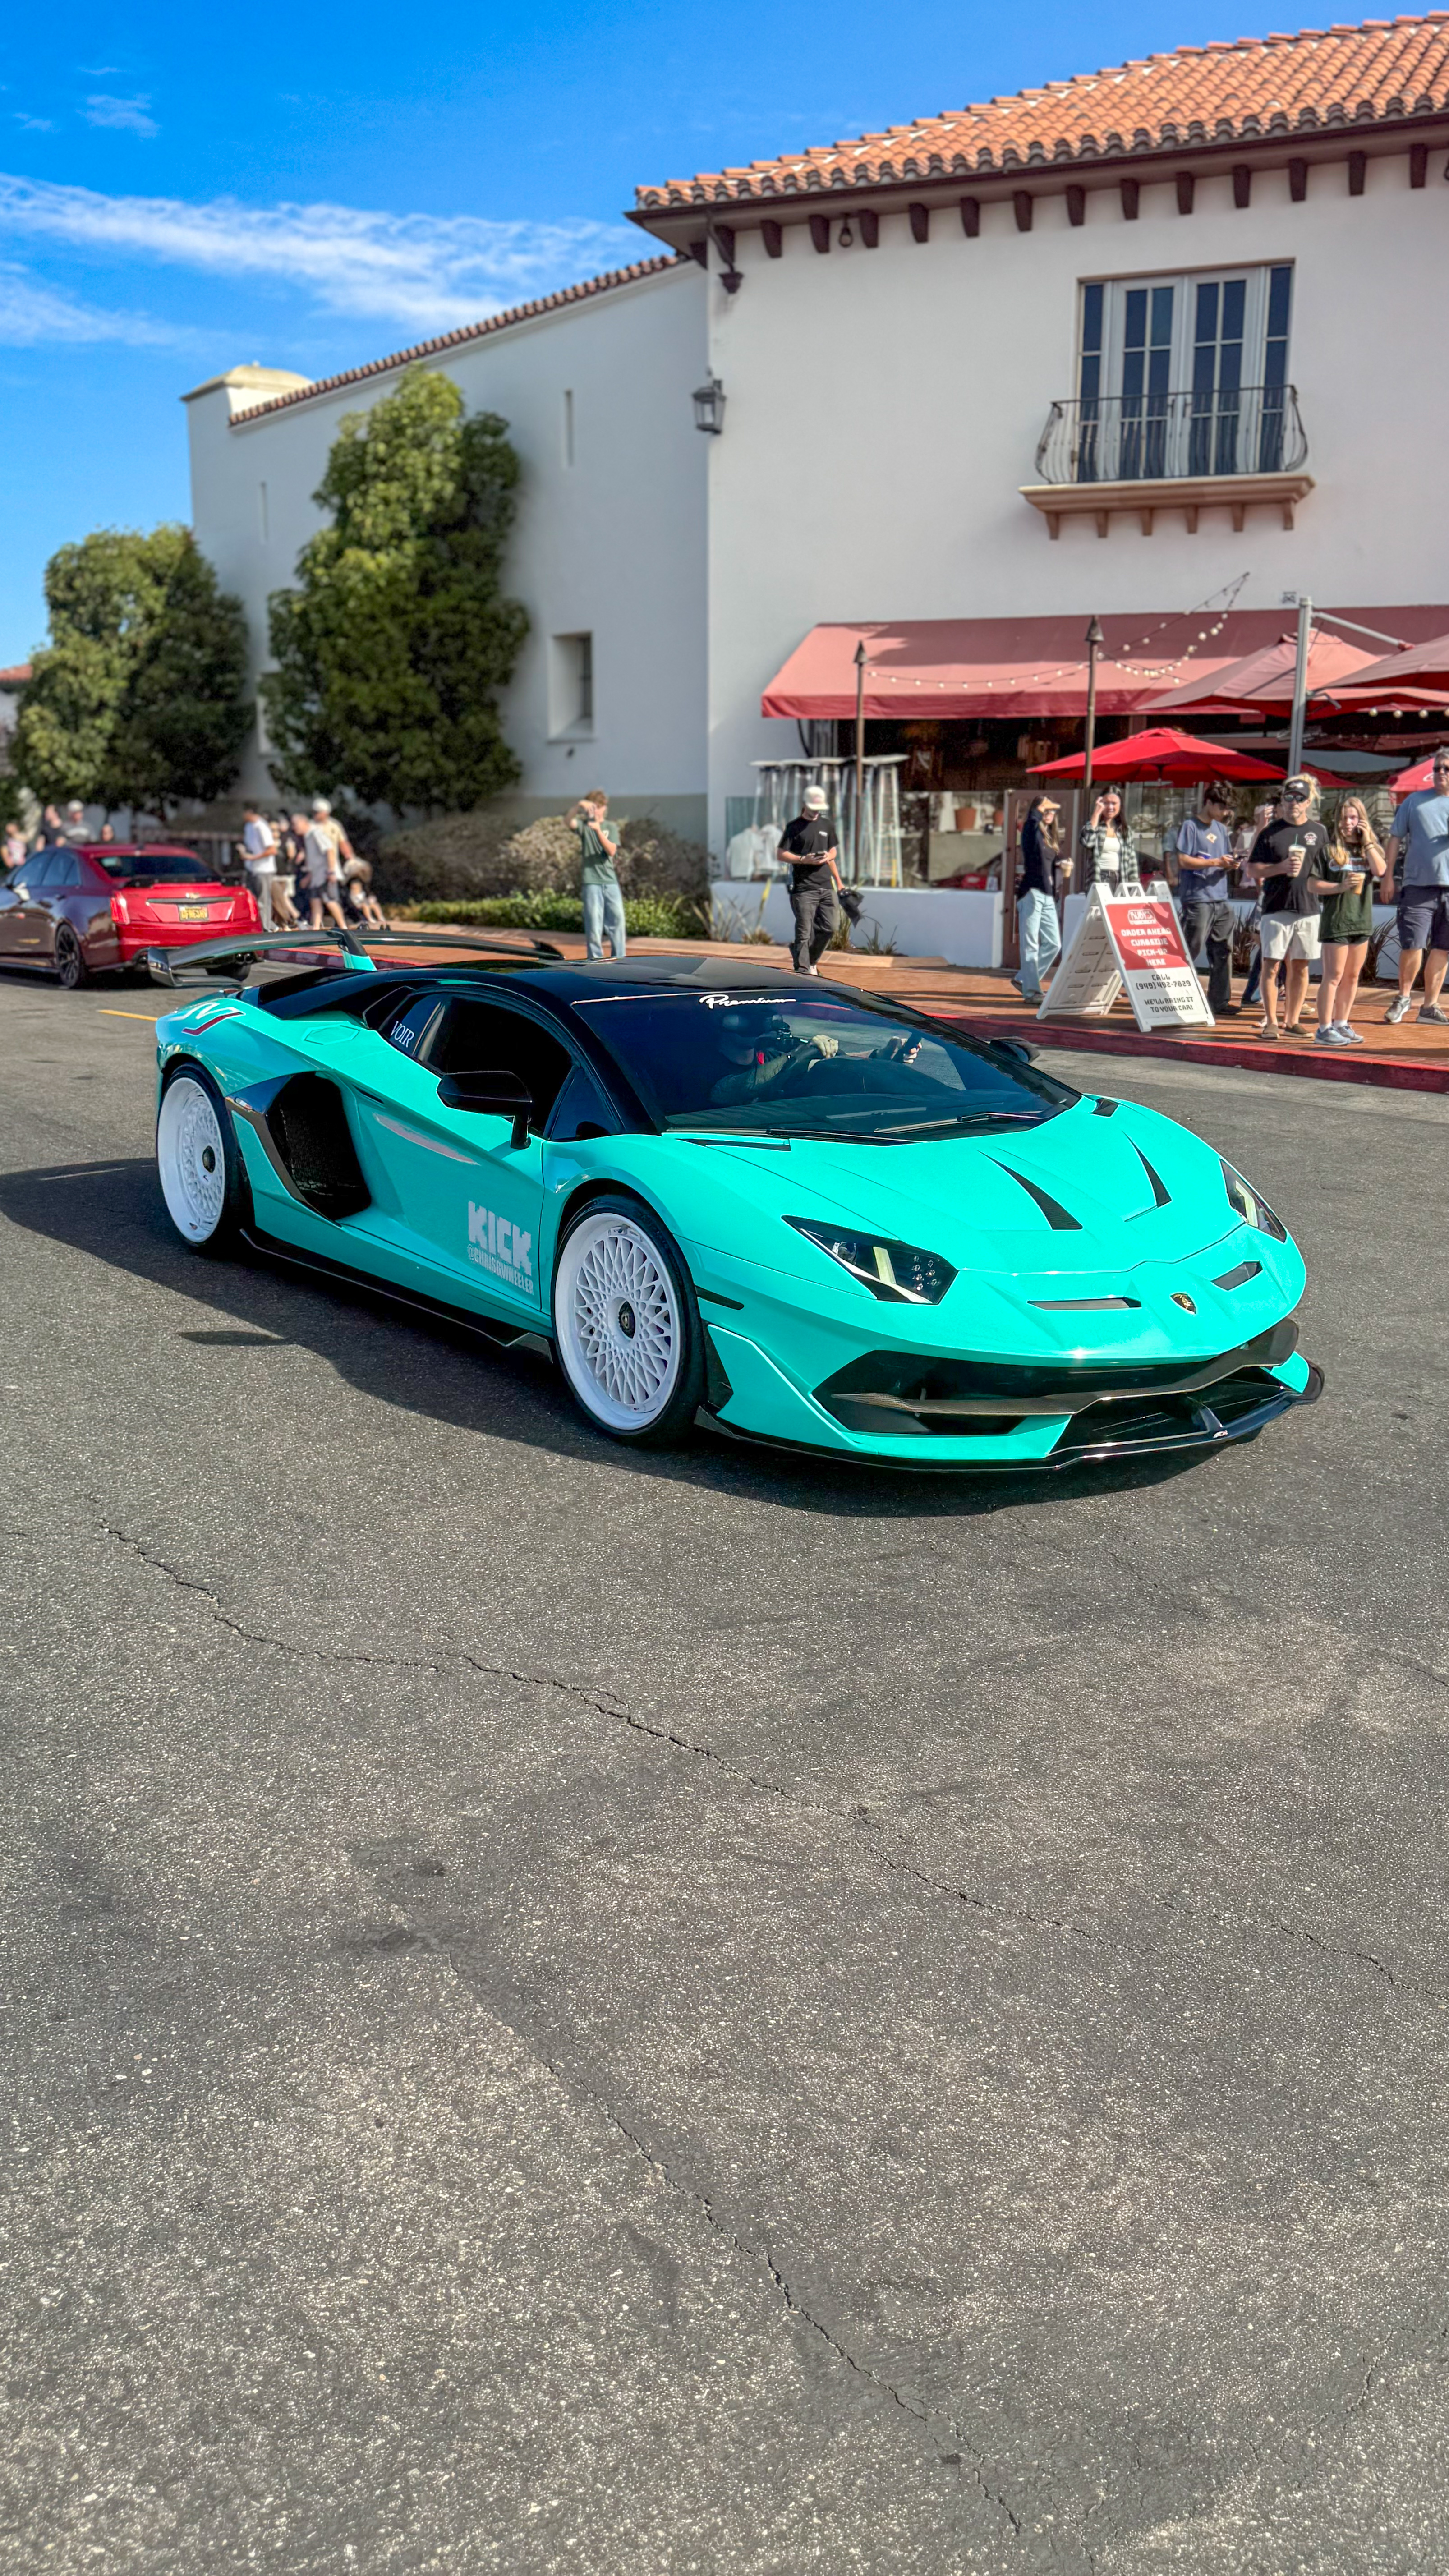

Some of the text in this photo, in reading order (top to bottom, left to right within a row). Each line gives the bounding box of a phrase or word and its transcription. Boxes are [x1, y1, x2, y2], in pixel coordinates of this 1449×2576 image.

[1130, 938, 1168, 946] CURBSIDE
[1137, 948, 1168, 956] PICK-UP
[1136, 982, 1156, 990] (949)
[699, 994, 796, 1009] Premium
[391, 1021, 414, 1048] VOIR
[468, 1200, 532, 1276] KICK
